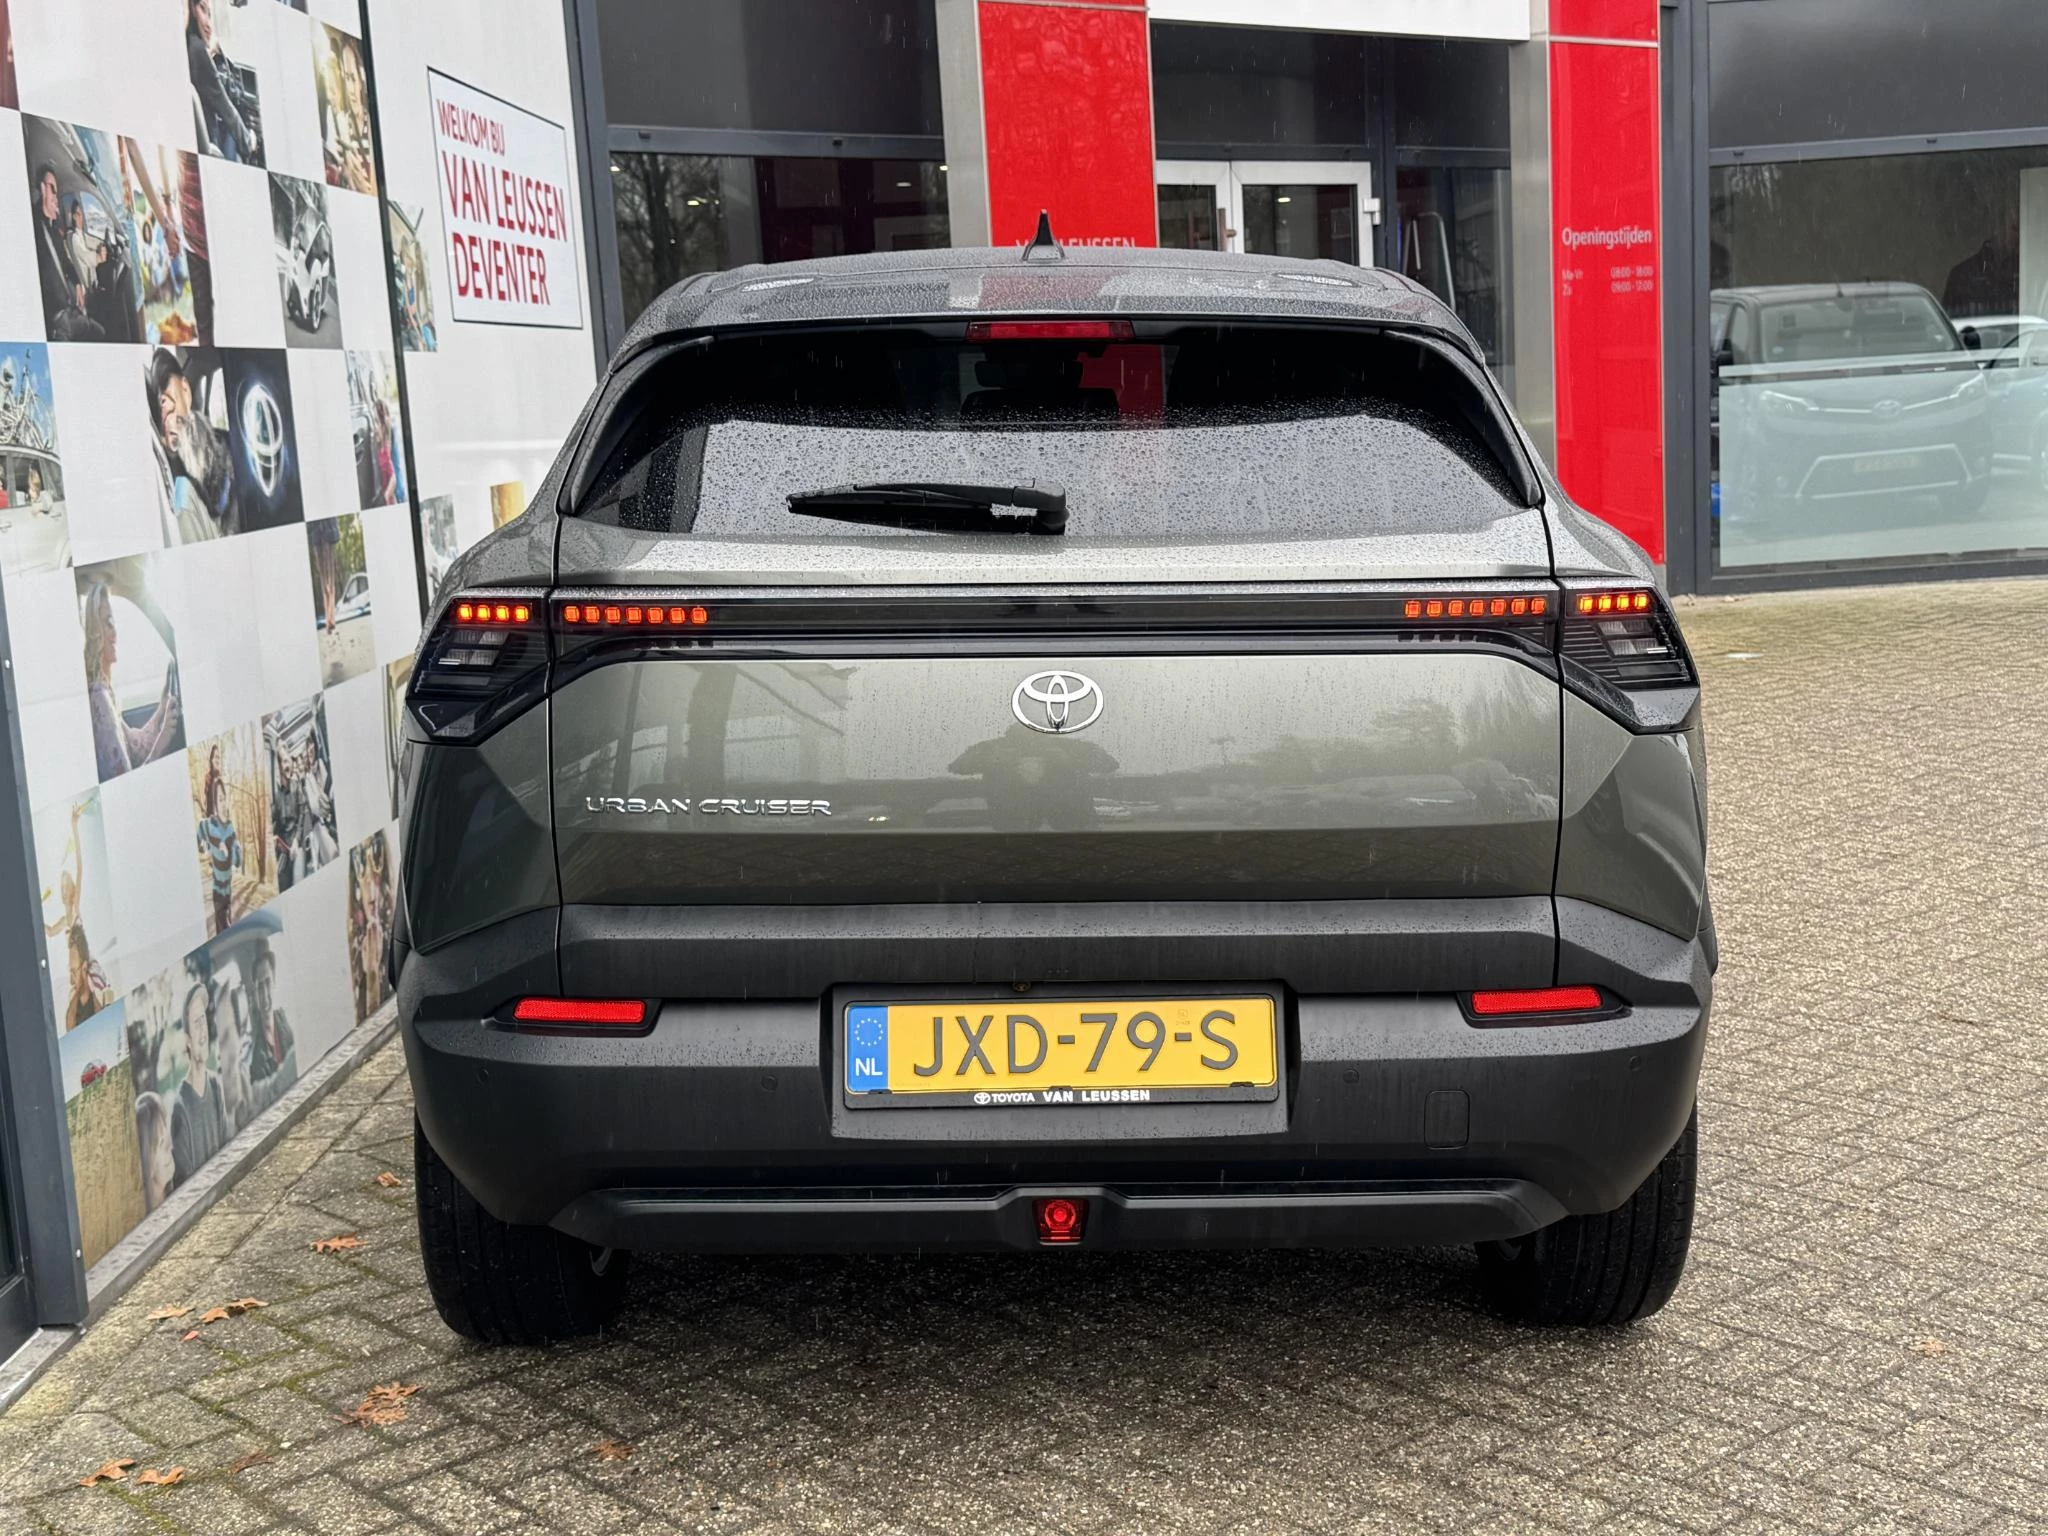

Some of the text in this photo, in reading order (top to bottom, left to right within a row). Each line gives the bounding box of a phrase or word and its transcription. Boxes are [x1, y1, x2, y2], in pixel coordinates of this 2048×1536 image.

[437, 99, 506, 156] WELKOM BIJ
[442, 150, 567, 242] VAN LEUSSEN
[1562, 226, 1653, 250] Openingstijden
[452, 232, 551, 305] DEVENTER
[586, 797, 832, 816] URBAN CRUISER
[913, 1009, 1239, 1077] JXD-79-S
[855, 1057, 883, 1077] NL
[992, 1089, 1150, 1103] TOYOTA VAN LEUSSEN
